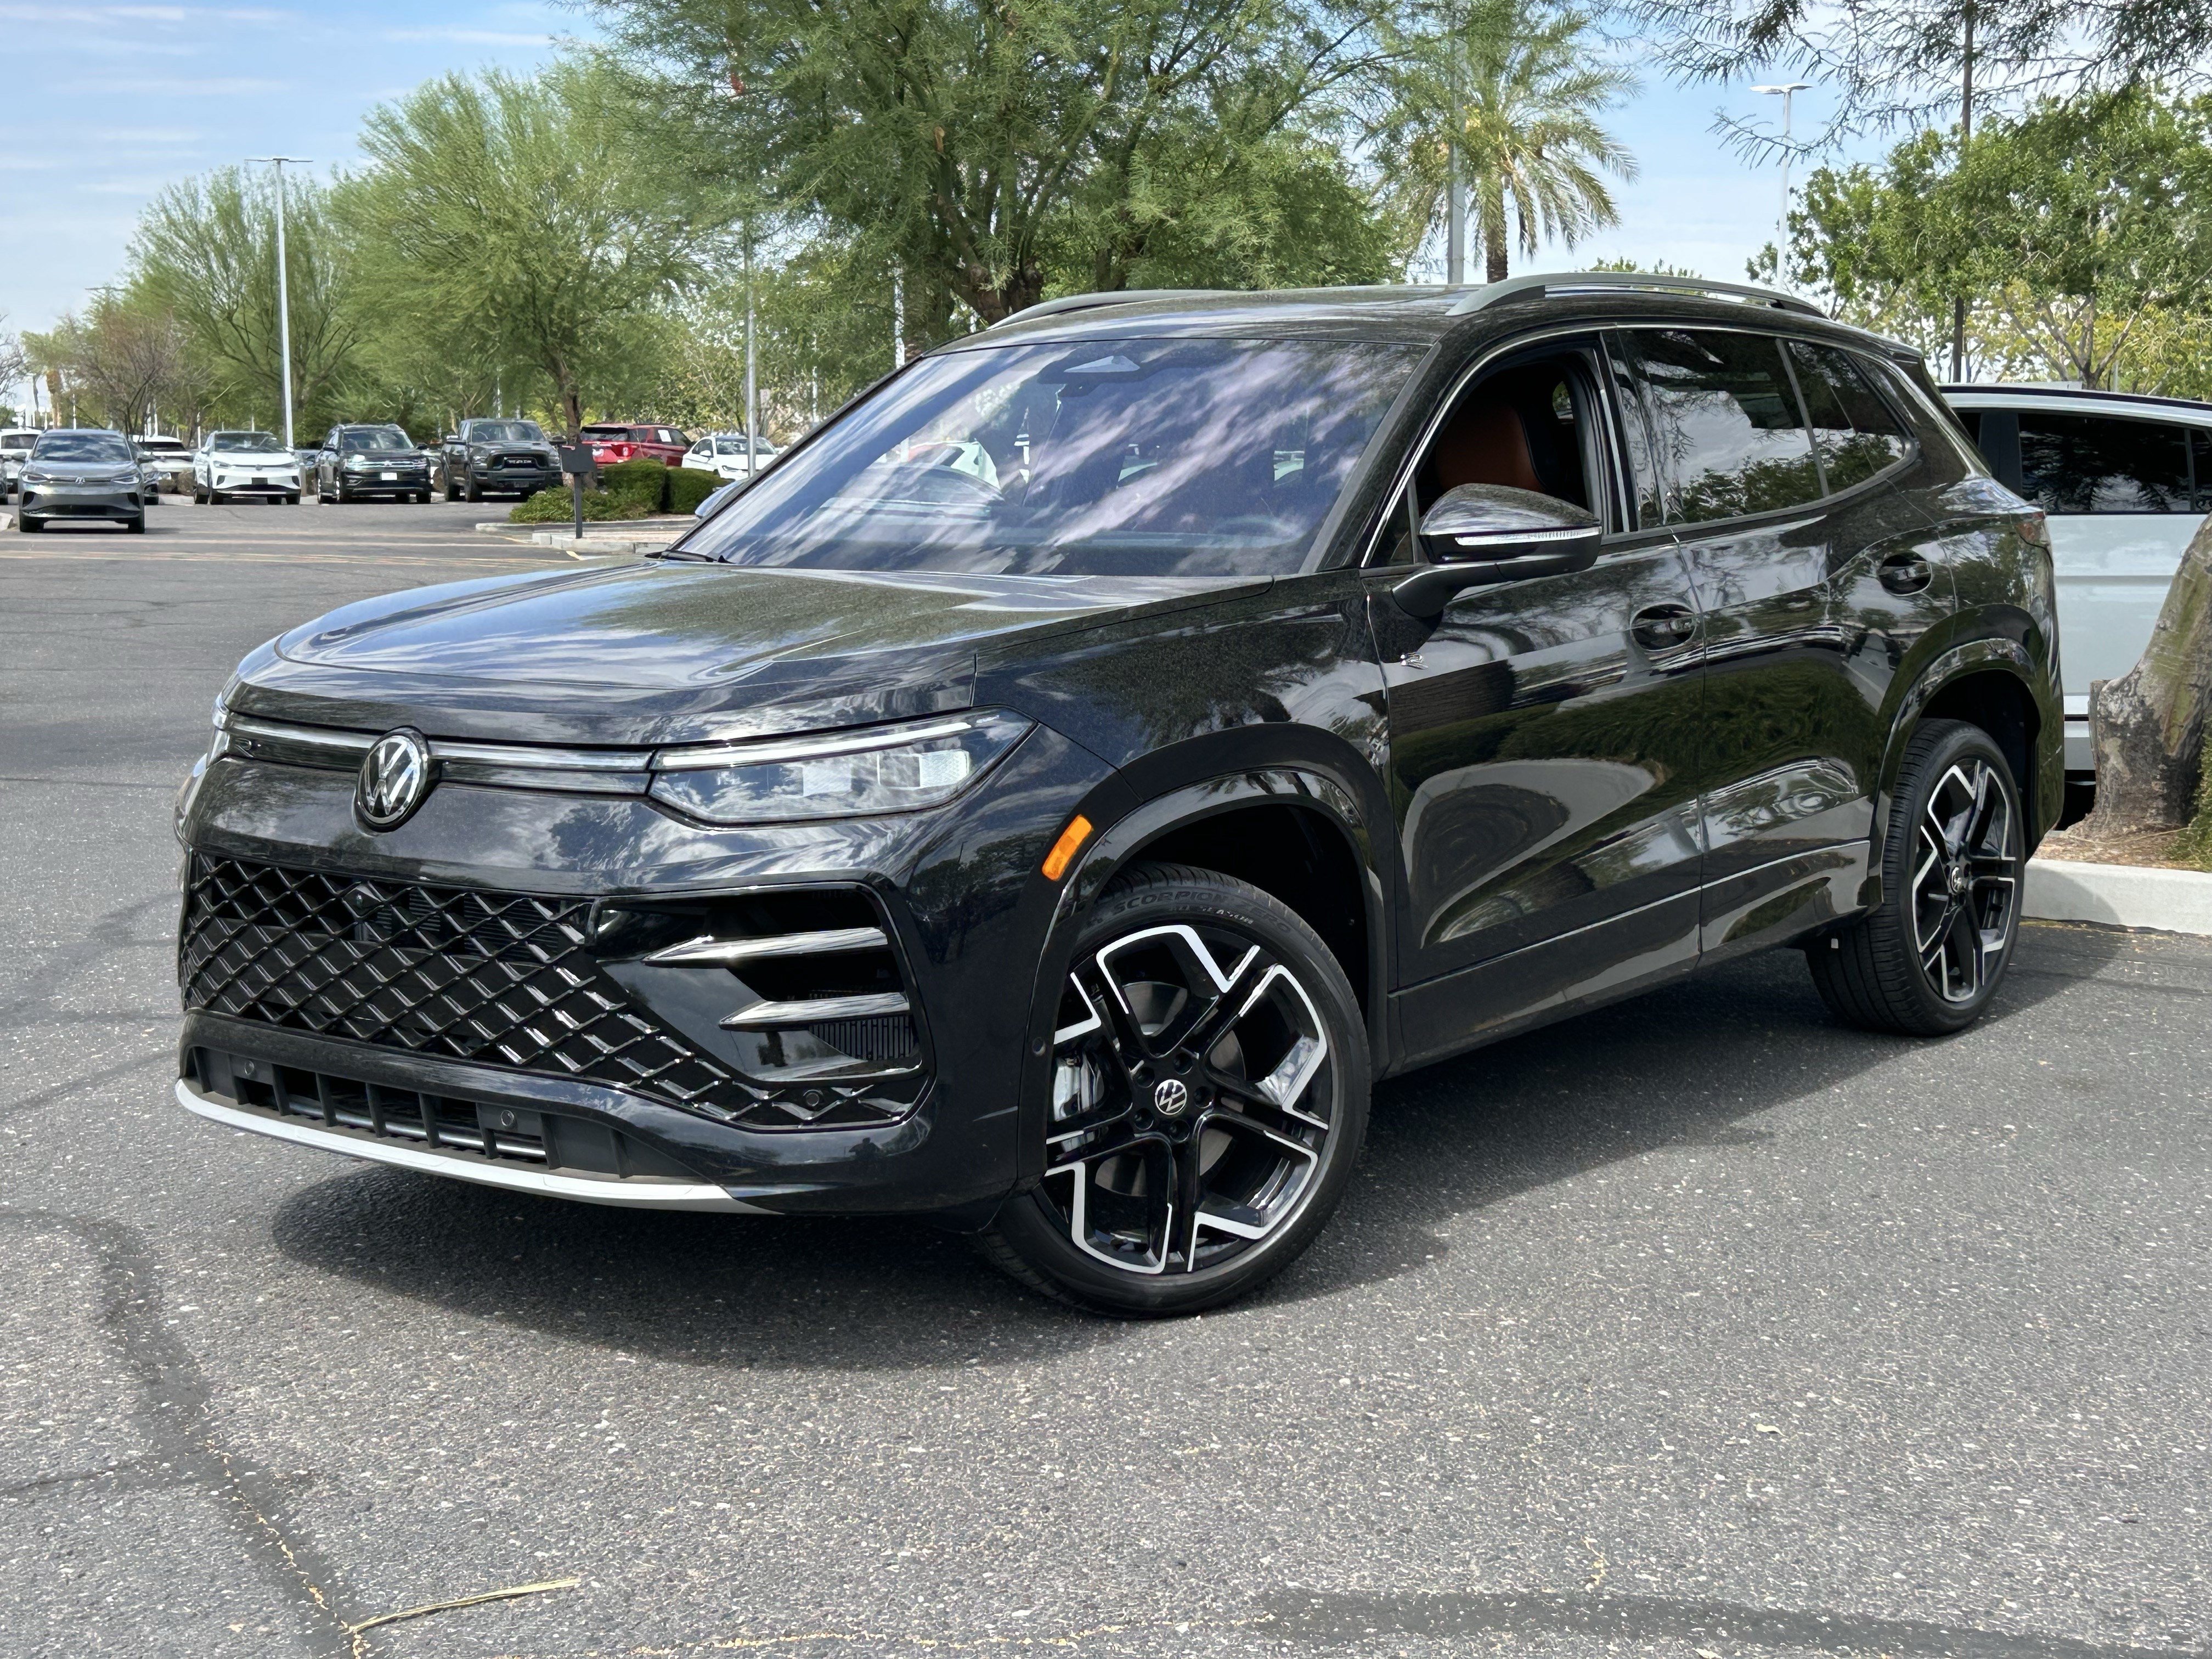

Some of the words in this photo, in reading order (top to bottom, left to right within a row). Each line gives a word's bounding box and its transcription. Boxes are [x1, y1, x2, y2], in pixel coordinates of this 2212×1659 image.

[358, 735, 421, 824] VW
[1113, 891, 1227, 915] SCORPION
[1155, 1079, 1187, 1115] VW
